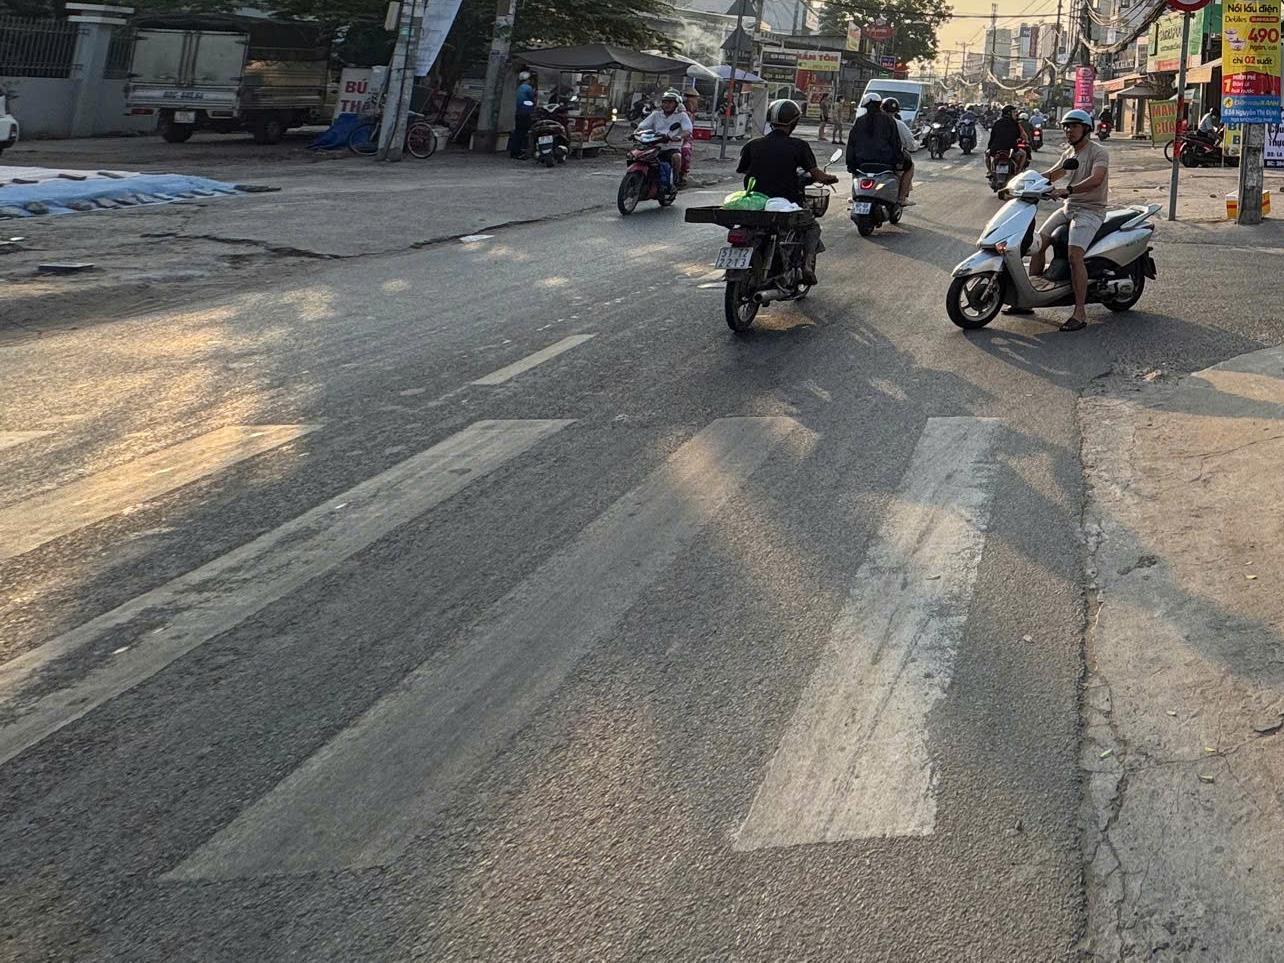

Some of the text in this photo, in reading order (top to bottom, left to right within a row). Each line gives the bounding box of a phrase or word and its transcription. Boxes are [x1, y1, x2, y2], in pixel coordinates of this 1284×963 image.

[1247, 27, 1280, 44] 490
[1244, 55, 1256, 65] 02
[345, 78, 368, 94] BÚ
[1223, 78, 1232, 93] 1
